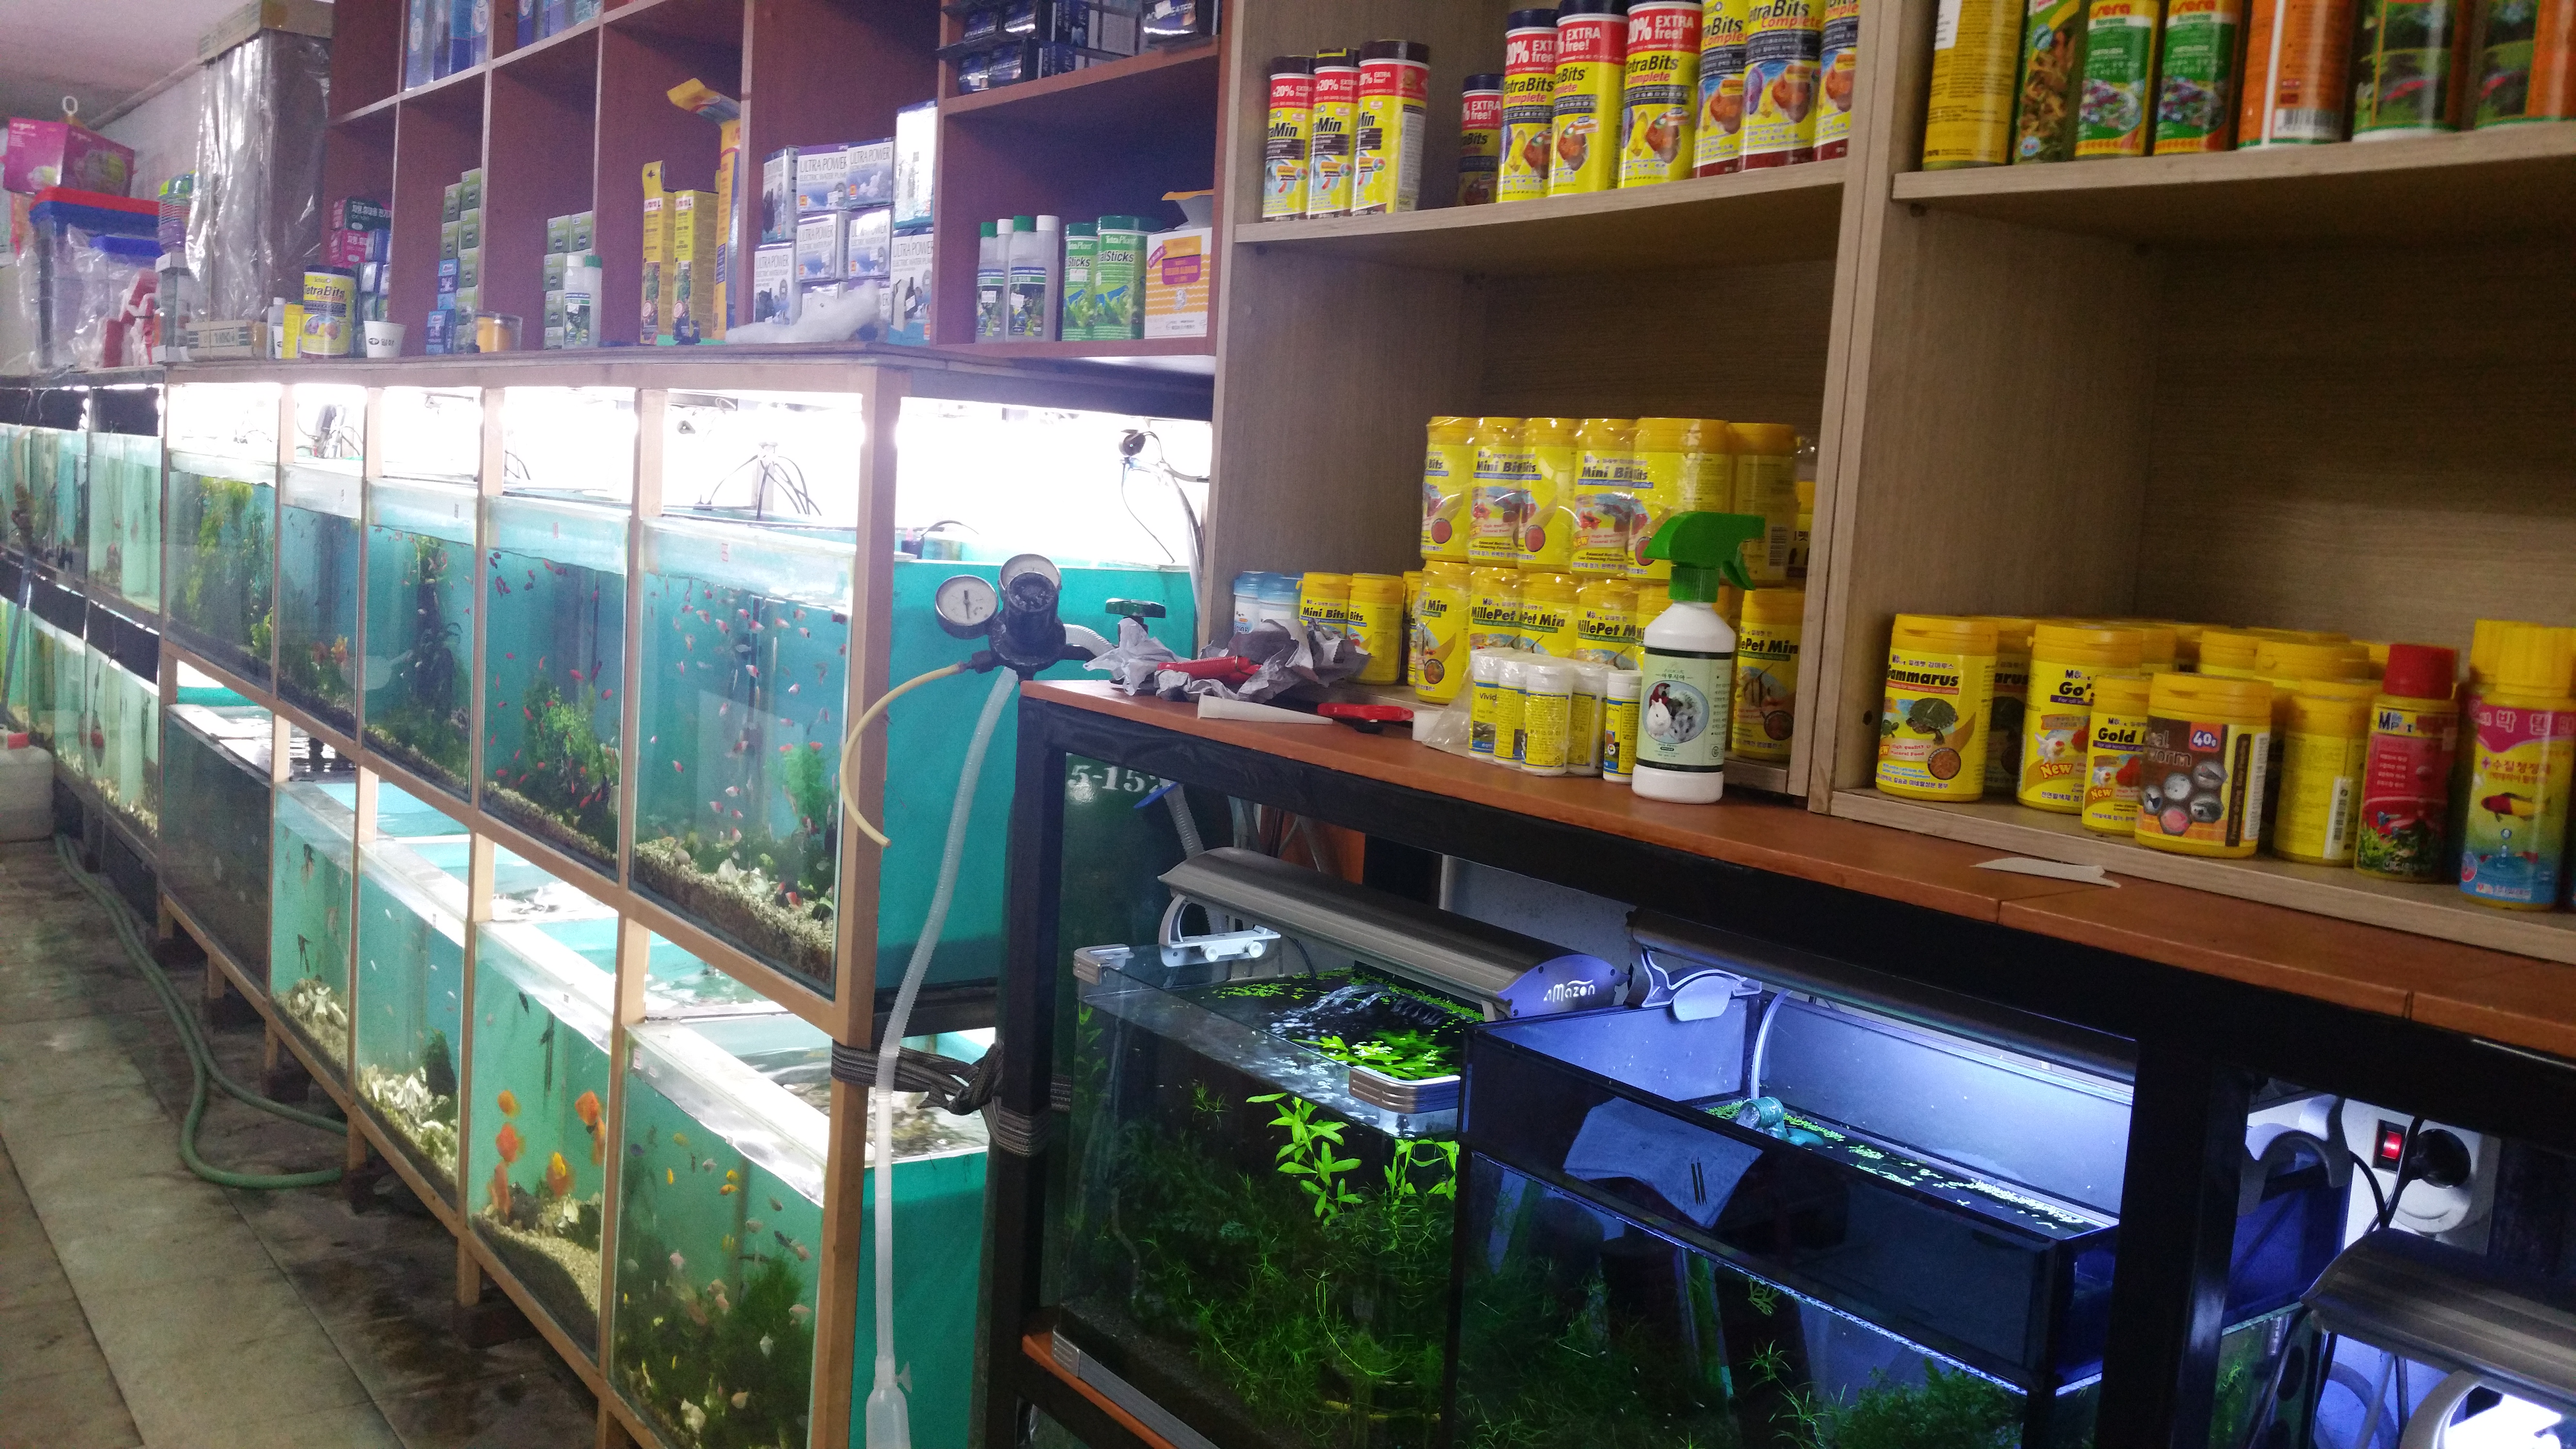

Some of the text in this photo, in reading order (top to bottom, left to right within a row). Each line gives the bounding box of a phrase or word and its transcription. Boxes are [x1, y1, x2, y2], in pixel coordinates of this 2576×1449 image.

[1655, 16, 1694, 28] EXTRA
[1566, 27, 1601, 40] EXTRA
[1655, 29, 1683, 40] free!
[1532, 40, 1555, 51] EXT
[1566, 39, 1590, 51] free!
[1531, 51, 1555, 63] free
[1471, 100, 1501, 111] EXTRA
[1470, 110, 1492, 120] free!
[1476, 460, 1499, 471] Mini
[1582, 466, 1609, 478] Mini
[1428, 599, 1448, 612] Min
[1303, 607, 1345, 619] Mini Bits
[1539, 613, 1566, 627] Min
[1767, 639, 1799, 654] Min
[1480, 692, 1497, 701] Vivid
[2098, 726, 2137, 743] Gold
[2040, 762, 2073, 779] New
[2091, 788, 2113, 800] New
